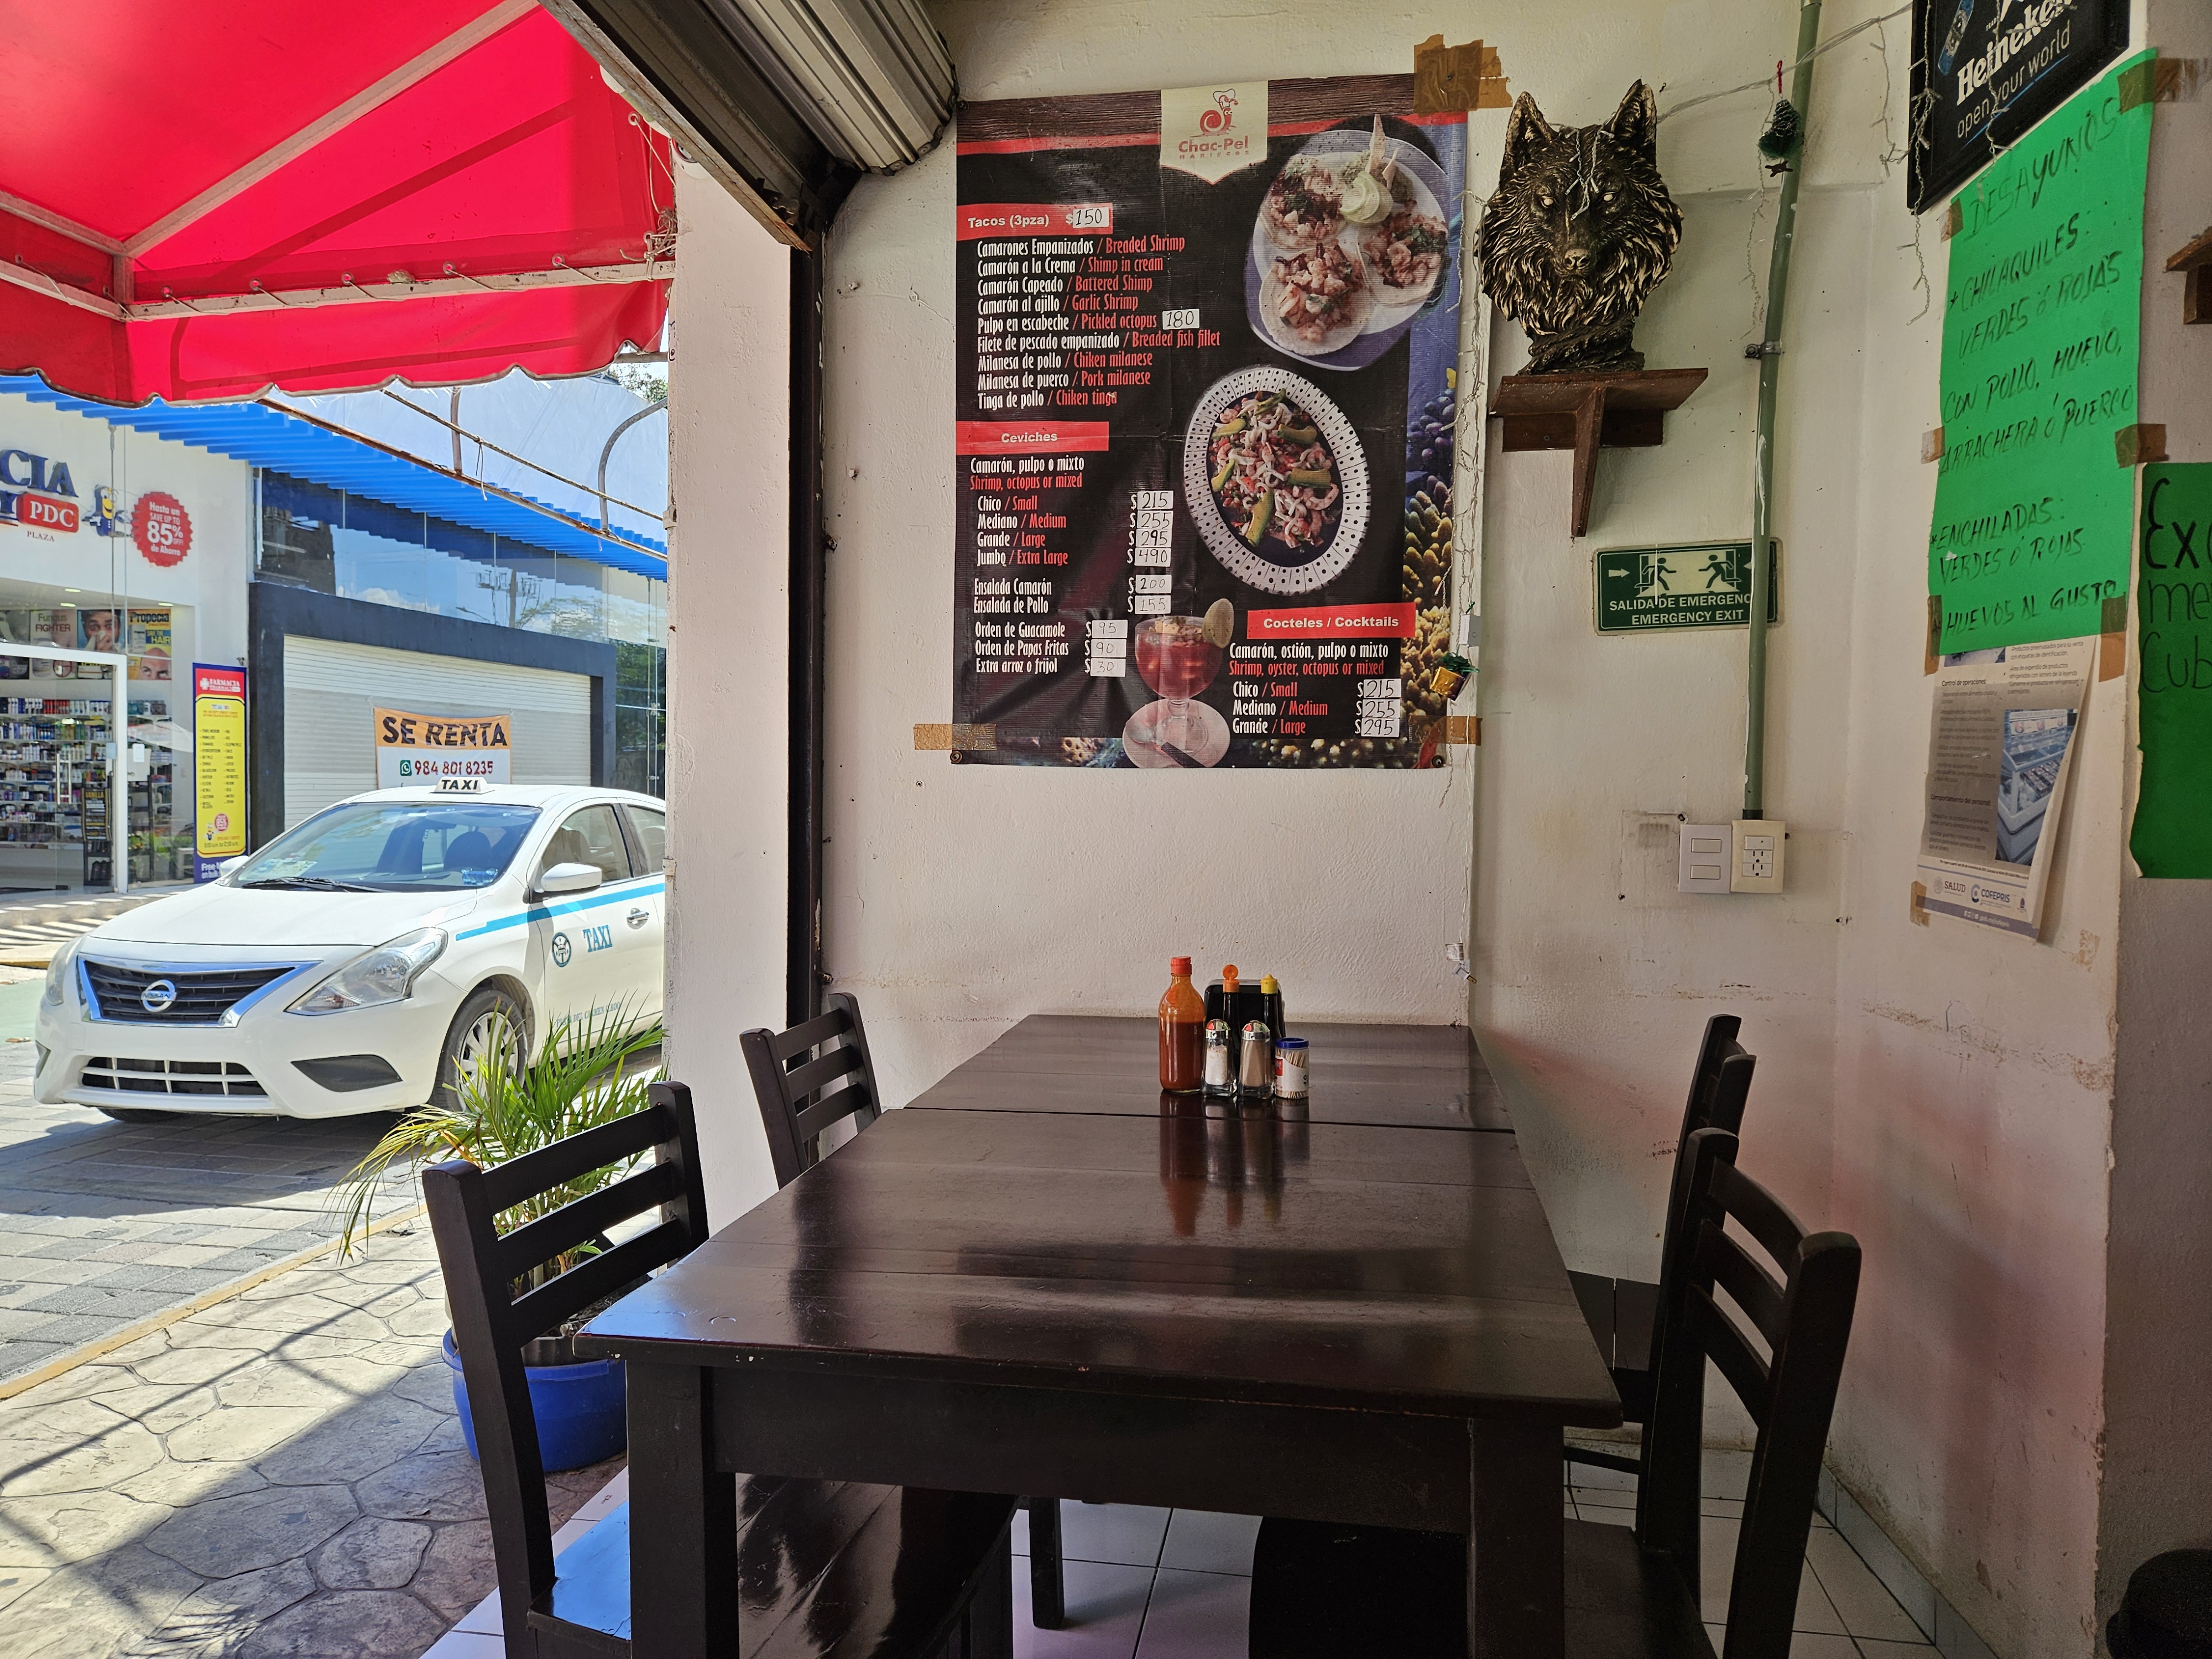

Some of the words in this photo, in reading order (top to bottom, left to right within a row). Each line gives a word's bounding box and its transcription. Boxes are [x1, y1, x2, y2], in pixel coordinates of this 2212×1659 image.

[1958, 98, 1990, 138] open
[1994, 66, 2025, 103] your
[2028, 19, 2070, 77] world
[1178, 135, 1249, 153] Chac-Pel
[968, 217, 1005, 228] Tacos
[1009, 214, 1050, 228] (3pza)
[977, 239, 1029, 258] Camarones
[1032, 238, 1094, 255] Empanizados
[1106, 236, 1146, 253] Breaded
[1150, 234, 1185, 252] Shrimp
[978, 259, 1019, 276] Camarón
[1045, 257, 1076, 274] Crema
[1088, 257, 1118, 274] Shimp
[1134, 257, 1163, 272] cream
[978, 278, 1019, 296] Camarón
[1022, 276, 1063, 294] Capeado
[1076, 275, 1119, 292] Battered
[1123, 274, 1152, 292] Shimp
[978, 296, 1019, 315] Camarón
[1034, 294, 1060, 314] ajillo
[1072, 294, 1100, 311] Garlic
[1104, 293, 1138, 312] Shrimp
[1959, 295, 2030, 359] VERDES
[2056, 250, 2123, 307] ROJAS
[978, 316, 1003, 335] Pulpo
[1021, 314, 1070, 331] escabeche
[1081, 312, 1117, 330] Pickled
[1120, 314, 1157, 330] octopus
[1166, 310, 1195, 328] 180
[978, 336, 1001, 353] Filete
[1005, 335, 1015, 351] de
[1019, 334, 1058, 352] pescado
[1061, 332, 1119, 351] empanizado
[1132, 331, 1173, 348] Breaded
[1176, 330, 1194, 349] fish
[1197, 330, 1220, 348] fillet
[978, 354, 1018, 372] Milanesa
[1037, 352, 1062, 370] pollo
[1073, 351, 1105, 369] Chiken
[1109, 351, 1152, 367] milanese
[978, 373, 1018, 391] Milanesa
[1022, 372, 1034, 388] de
[1037, 374, 1069, 390] puerco
[1082, 371, 1103, 387] Pork
[1107, 369, 1150, 386] milanese
[978, 393, 1003, 411] Tinga
[1021, 390, 1044, 409] pollo
[1056, 389, 1088, 406] Chiken
[1943, 383, 1978, 424] CON
[2060, 385, 2135, 442] PUERCO
[1001, 431, 1058, 444] Ceviches
[971, 457, 1015, 475] Camarón,
[1019, 456, 1045, 475] pulpo
[1057, 455, 1084, 472] mixto
[970, 474, 1003, 492] Shrimp,
[1006, 474, 1040, 491] octopus
[1056, 472, 1082, 488] mixed
[149, 501, 170, 514] Hasta
[978, 495, 1001, 512] Chico
[1012, 495, 1037, 510] Small
[30, 500, 74, 528] PDC
[150, 512, 163, 521] SAVE
[164, 515, 173, 523] UP
[173, 517, 180, 525] TO
[977, 513, 1018, 530] Mediano
[1029, 513, 1067, 529] Medium
[2145, 477, 2212, 570] Ex
[27, 530, 55, 542] PLAZA
[977, 531, 1010, 547] Grande
[1021, 531, 1046, 547] Large
[150, 543, 159, 552] de
[160, 545, 181, 556] Ahorro
[977, 549, 1006, 567] Jumbo
[1017, 550, 1040, 566] Extra
[1044, 549, 1068, 566] Large
[1939, 547, 2004, 586] VERDES
[2029, 527, 2086, 567] ROJAS
[974, 578, 1010, 596] Ensalada
[1013, 578, 1052, 596] Camarón
[974, 596, 1010, 614] Ensalada
[1027, 597, 1048, 614] Pollo
[1609, 598, 1655, 611] SALIDA
[1658, 597, 1676, 608] DE
[1679, 593, 1752, 607] EMERGENC
[1944, 602, 2015, 640] HUEVOS
[2021, 594, 2041, 619] AL
[2049, 579, 2117, 611] GUSTO
[2148, 579, 2212, 624] me
[38, 613, 68, 624] Fungus
[129, 612, 170, 624] Propecia
[1263, 617, 1323, 628] Cocteles
[1334, 615, 1399, 628] Cocktails
[1631, 610, 1712, 625] EMERGENCY
[1715, 609, 1744, 622] EXIT
[35, 623, 71, 633] FIGHTER
[975, 622, 1001, 638] Orden
[1018, 621, 1065, 638] Guacamole
[151, 636, 171, 644] HAIR
[975, 639, 1001, 656] Orden
[1018, 640, 1042, 658] Papas
[1045, 639, 1069, 656] Fritas
[1229, 642, 1277, 660] Camarón,
[1281, 641, 1314, 660] ostión,
[1318, 641, 1347, 660] pulpo
[1359, 641, 1389, 658] mixto
[976, 658, 999, 673] Extra
[1001, 660, 1024, 674] arroz
[1035, 656, 1057, 675] frijol
[1229, 660, 1264, 677] Shrimp,
[1268, 662, 1298, 677] oyster,
[1303, 661, 1339, 677] octopus
[1357, 660, 1384, 675] mixed
[210, 678, 241, 687] FARMACIA
[1233, 681, 1259, 697] Chico
[1270, 681, 1298, 697] Small
[1233, 700, 1276, 716] Mediano
[1288, 701, 1328, 716] Medium
[383, 716, 417, 744] SE
[425, 722, 508, 747] RENTA
[1232, 718, 1268, 734] Grande
[1280, 719, 1306, 735] Large
[414, 760, 439, 775] 984
[442, 761, 462, 776] 801
[466, 760, 493, 775] 8235
[441, 779, 479, 790] TAXI
[1944, 880, 1966, 893] SALUD
[1980, 888, 2011, 903] COFEPRIS
[582, 924, 613, 953] TAXI
